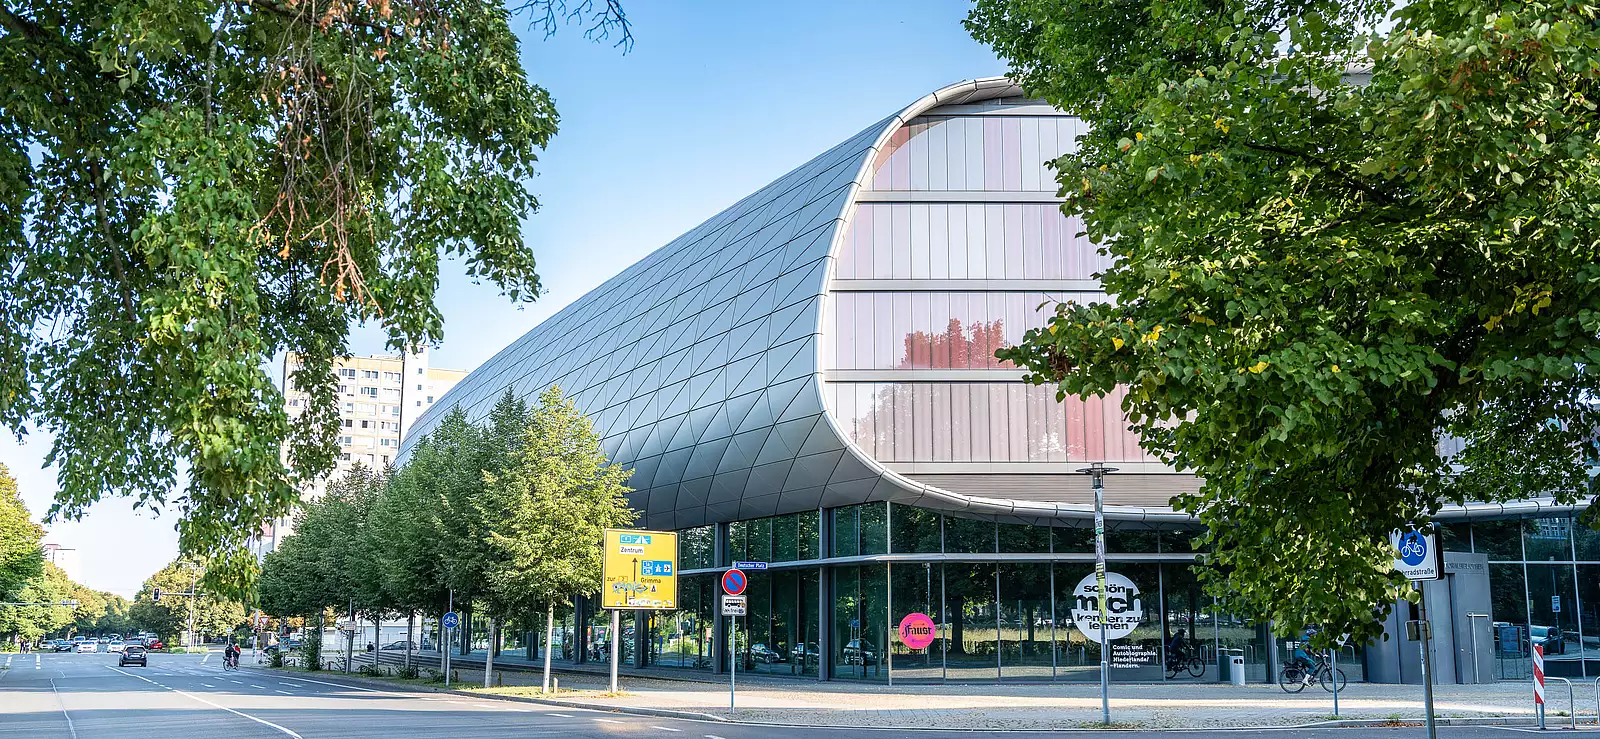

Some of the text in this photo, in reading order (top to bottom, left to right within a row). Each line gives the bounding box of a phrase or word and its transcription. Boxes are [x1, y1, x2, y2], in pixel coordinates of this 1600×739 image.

[620, 546, 644, 554] Zentrum
[1402, 567, 1435, 576] rradstraße
[1083, 584, 1125, 593] scön
[1071, 588, 1143, 613] mch
[1077, 613, 1124, 623] kenen
[1088, 621, 1129, 630] lenen
[902, 623, 932, 638] Faust
